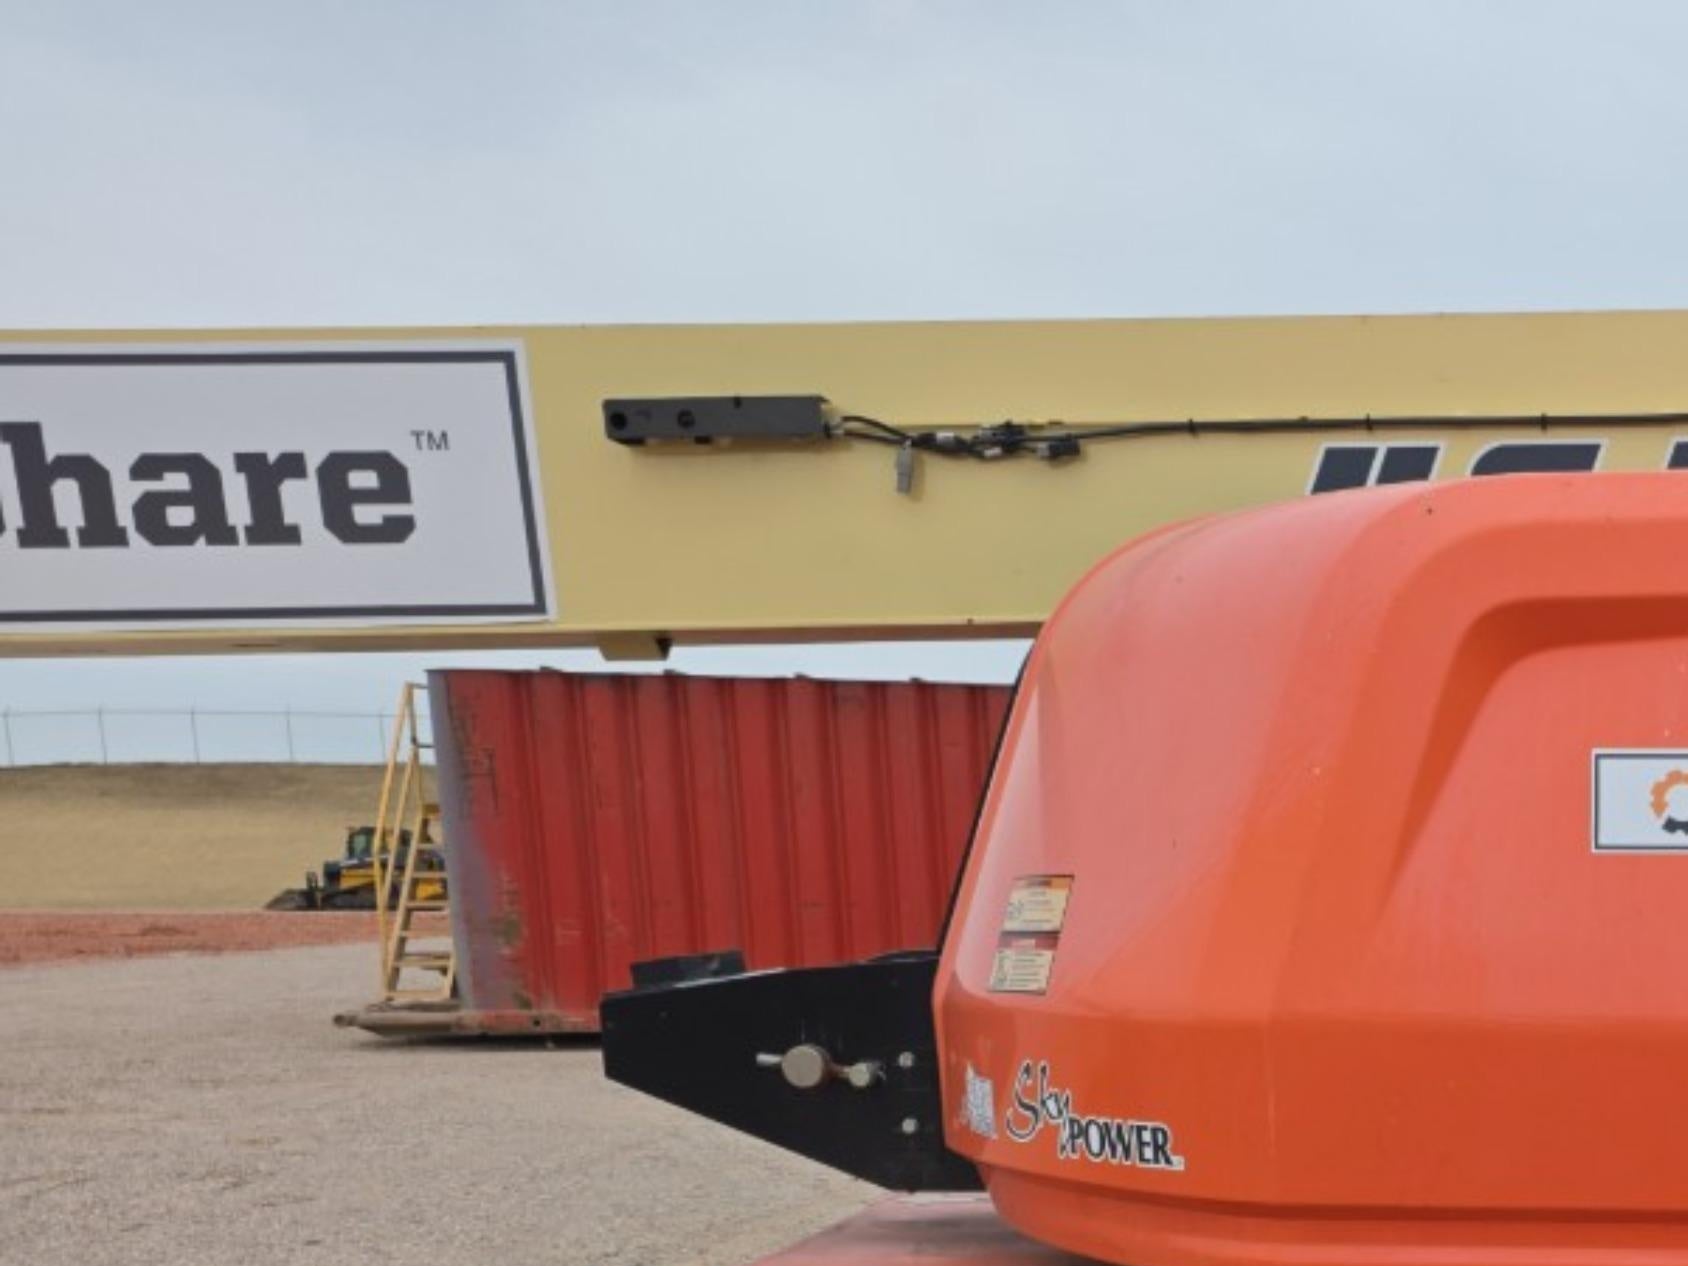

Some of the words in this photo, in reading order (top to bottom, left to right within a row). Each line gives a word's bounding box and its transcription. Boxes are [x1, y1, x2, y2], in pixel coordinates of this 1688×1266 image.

[0, 421, 416, 549] hare
[1006, 1062, 1070, 1153] Sky
[1067, 1117, 1174, 1165] POWER
